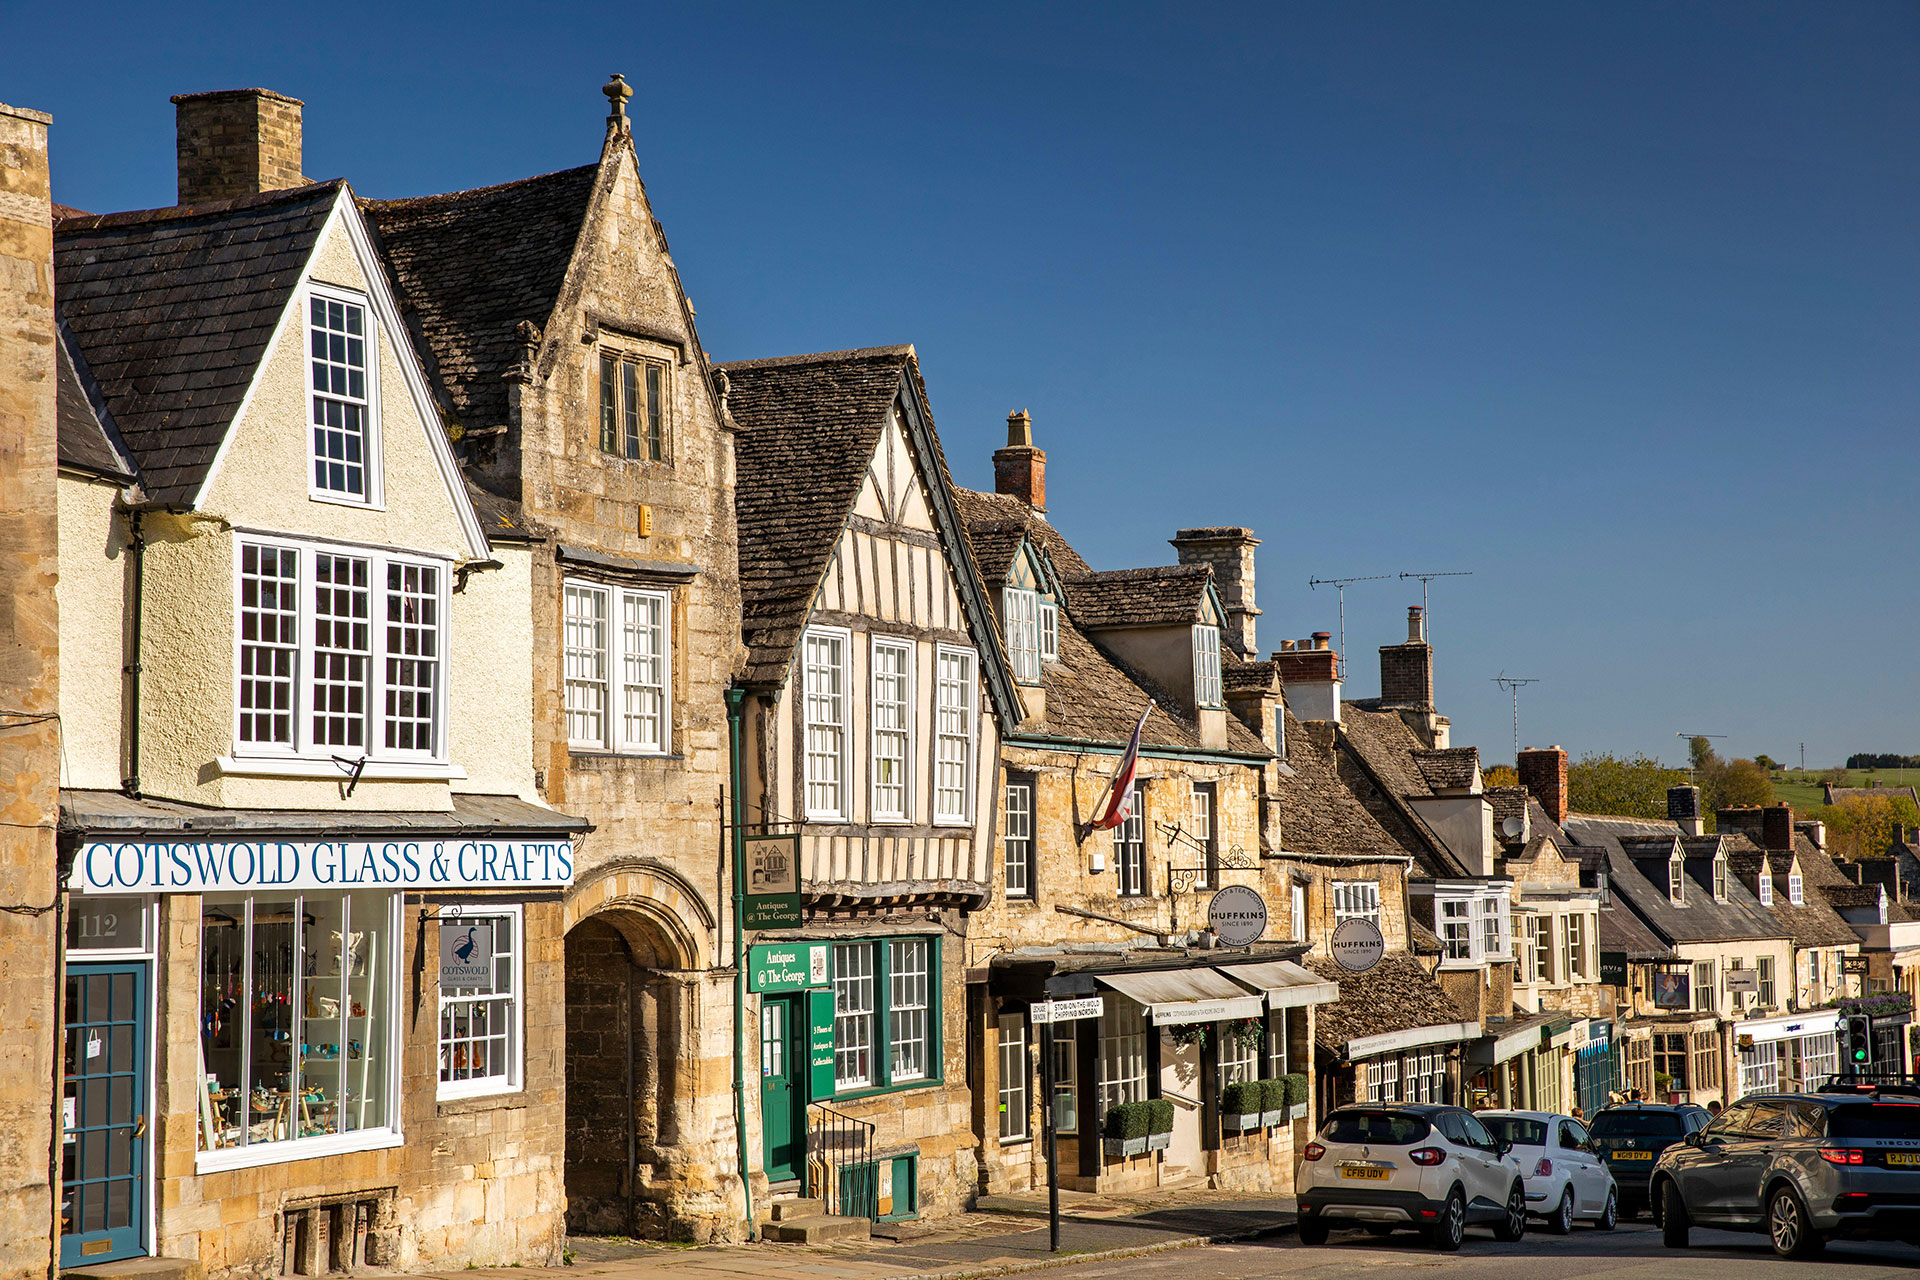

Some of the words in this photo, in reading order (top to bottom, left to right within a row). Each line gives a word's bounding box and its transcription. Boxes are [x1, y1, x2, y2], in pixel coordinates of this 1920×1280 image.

[86, 842, 300, 887] COTSWOLD
[311, 842, 420, 883] GLASS
[430, 842, 450, 882] &
[458, 842, 572, 882] CRAFTS
[1212, 891, 1228, 910] BAKERY
[1247, 891, 1263, 910] ROOMS
[756, 902, 788, 911] Antiques
[747, 913, 755, 923] @
[757, 912, 771, 920] The
[772, 911, 799, 921] George
[79, 913, 118, 938] 112
[1219, 931, 1259, 944] COTSWOLDS
[766, 950, 796, 967] Antiques
[1342, 958, 1377, 969] COTSWOLDS
[442, 966, 488, 975] COTSWOLD
[758, 970, 766, 987] @
[766, 969, 781, 983] The
[782, 968, 806, 985] George
[1054, 1000, 1100, 1012] STOW-ON-THE-WOLD
[1055, 1010, 1077, 1019] CHIPPING
[813, 1026, 817, 1035] 3
[817, 1025, 828, 1034] Floors
[828, 1024, 833, 1032] of
[813, 1042, 828, 1051] Antiques
[1890, 1153, 1914, 1163] RJ70
[1346, 1168, 1365, 1177] CF19
[1367, 1169, 1384, 1178] UDV
